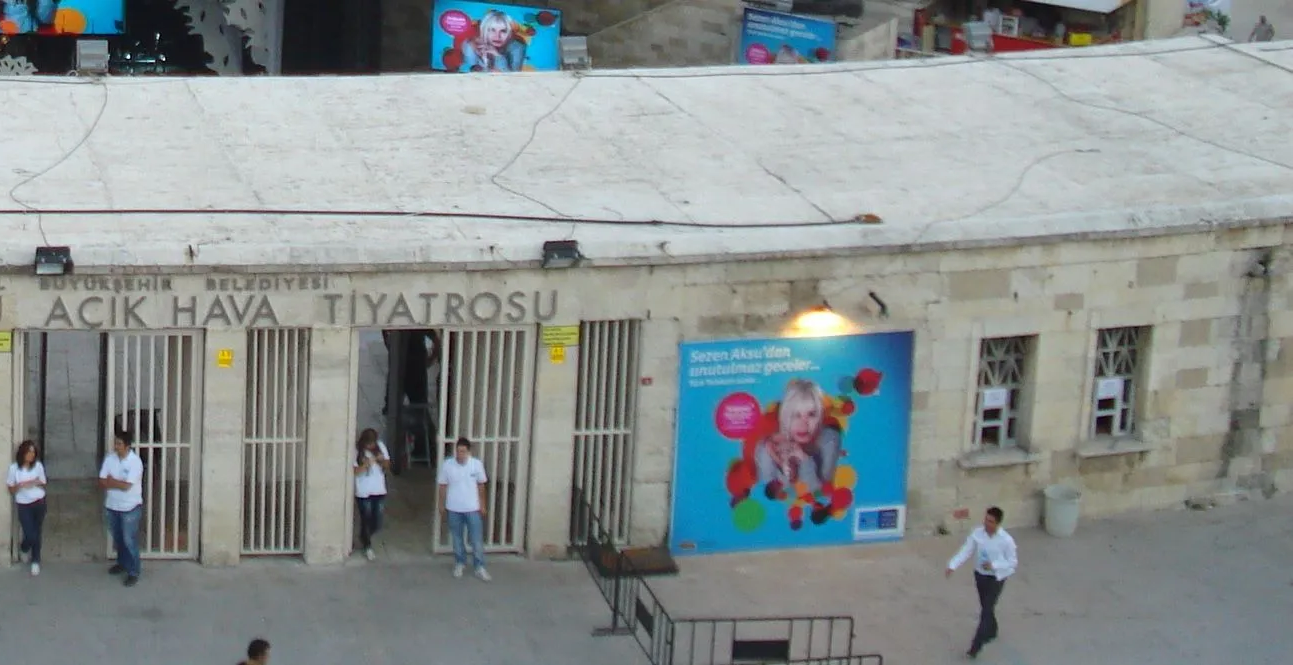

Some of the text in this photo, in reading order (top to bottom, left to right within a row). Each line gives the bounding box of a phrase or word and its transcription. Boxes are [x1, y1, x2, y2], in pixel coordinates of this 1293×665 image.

[172, 294, 280, 326] HAVA
[323, 289, 558, 324] TİYATROSU
[690, 345, 791, 364] Sezen Aksu'dan
[690, 361, 762, 377] unutulmaz
